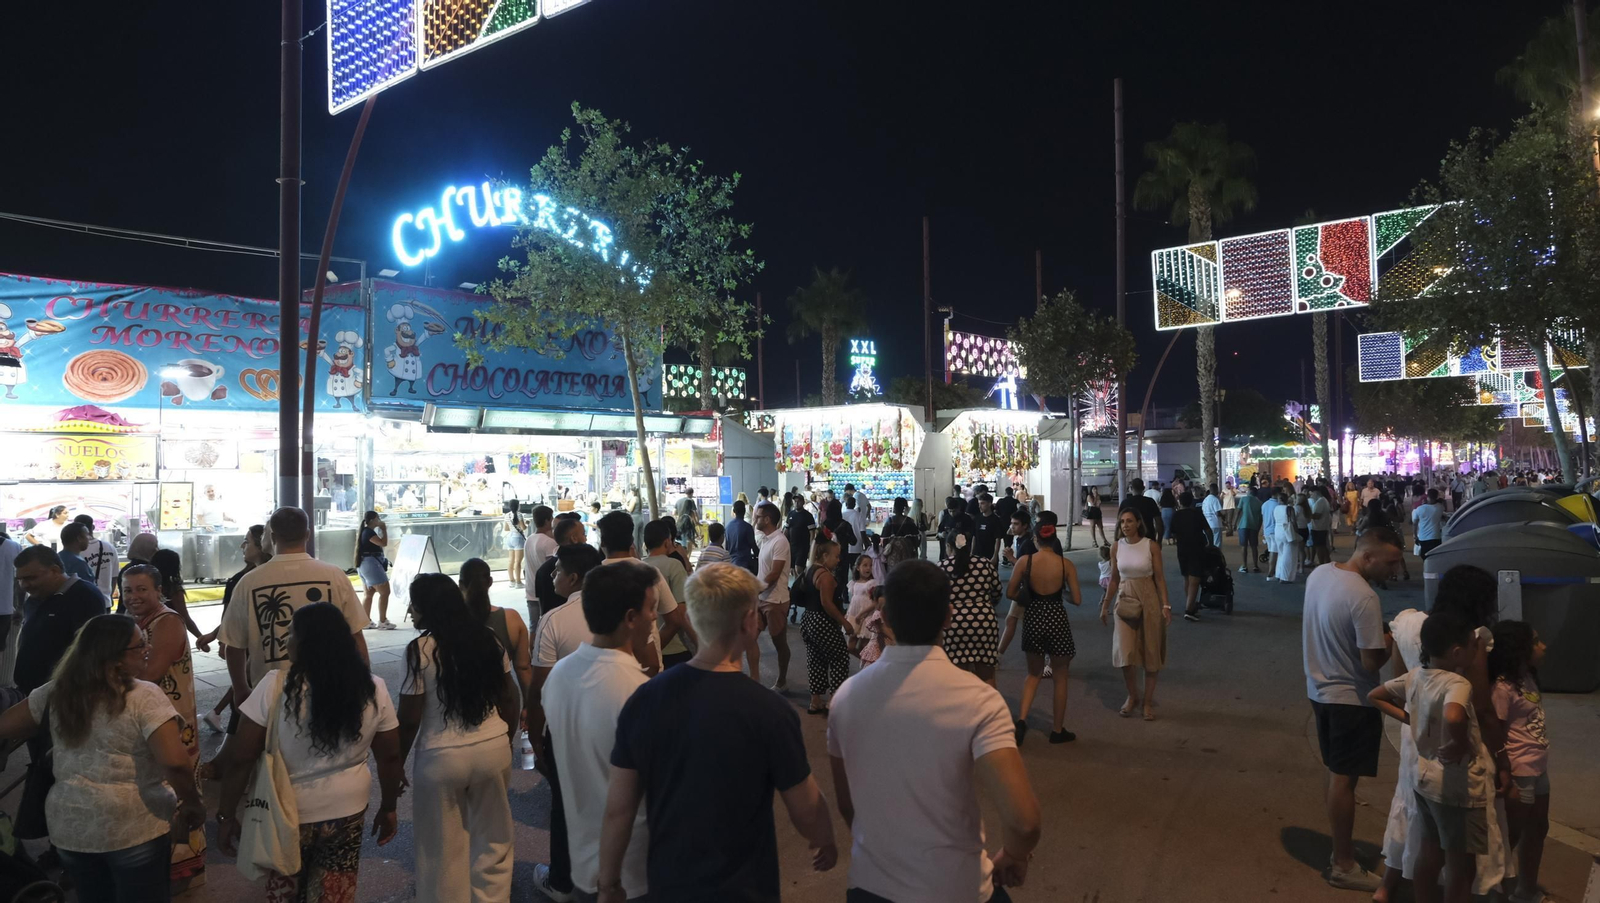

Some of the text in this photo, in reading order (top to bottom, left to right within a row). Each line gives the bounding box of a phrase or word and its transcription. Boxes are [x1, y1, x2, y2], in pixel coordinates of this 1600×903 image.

[88, 322, 280, 360] MORENO
[850, 339, 877, 355] XXL
[850, 355, 876, 367] SUPER
[426, 361, 628, 402] CHOCOLATERIA
